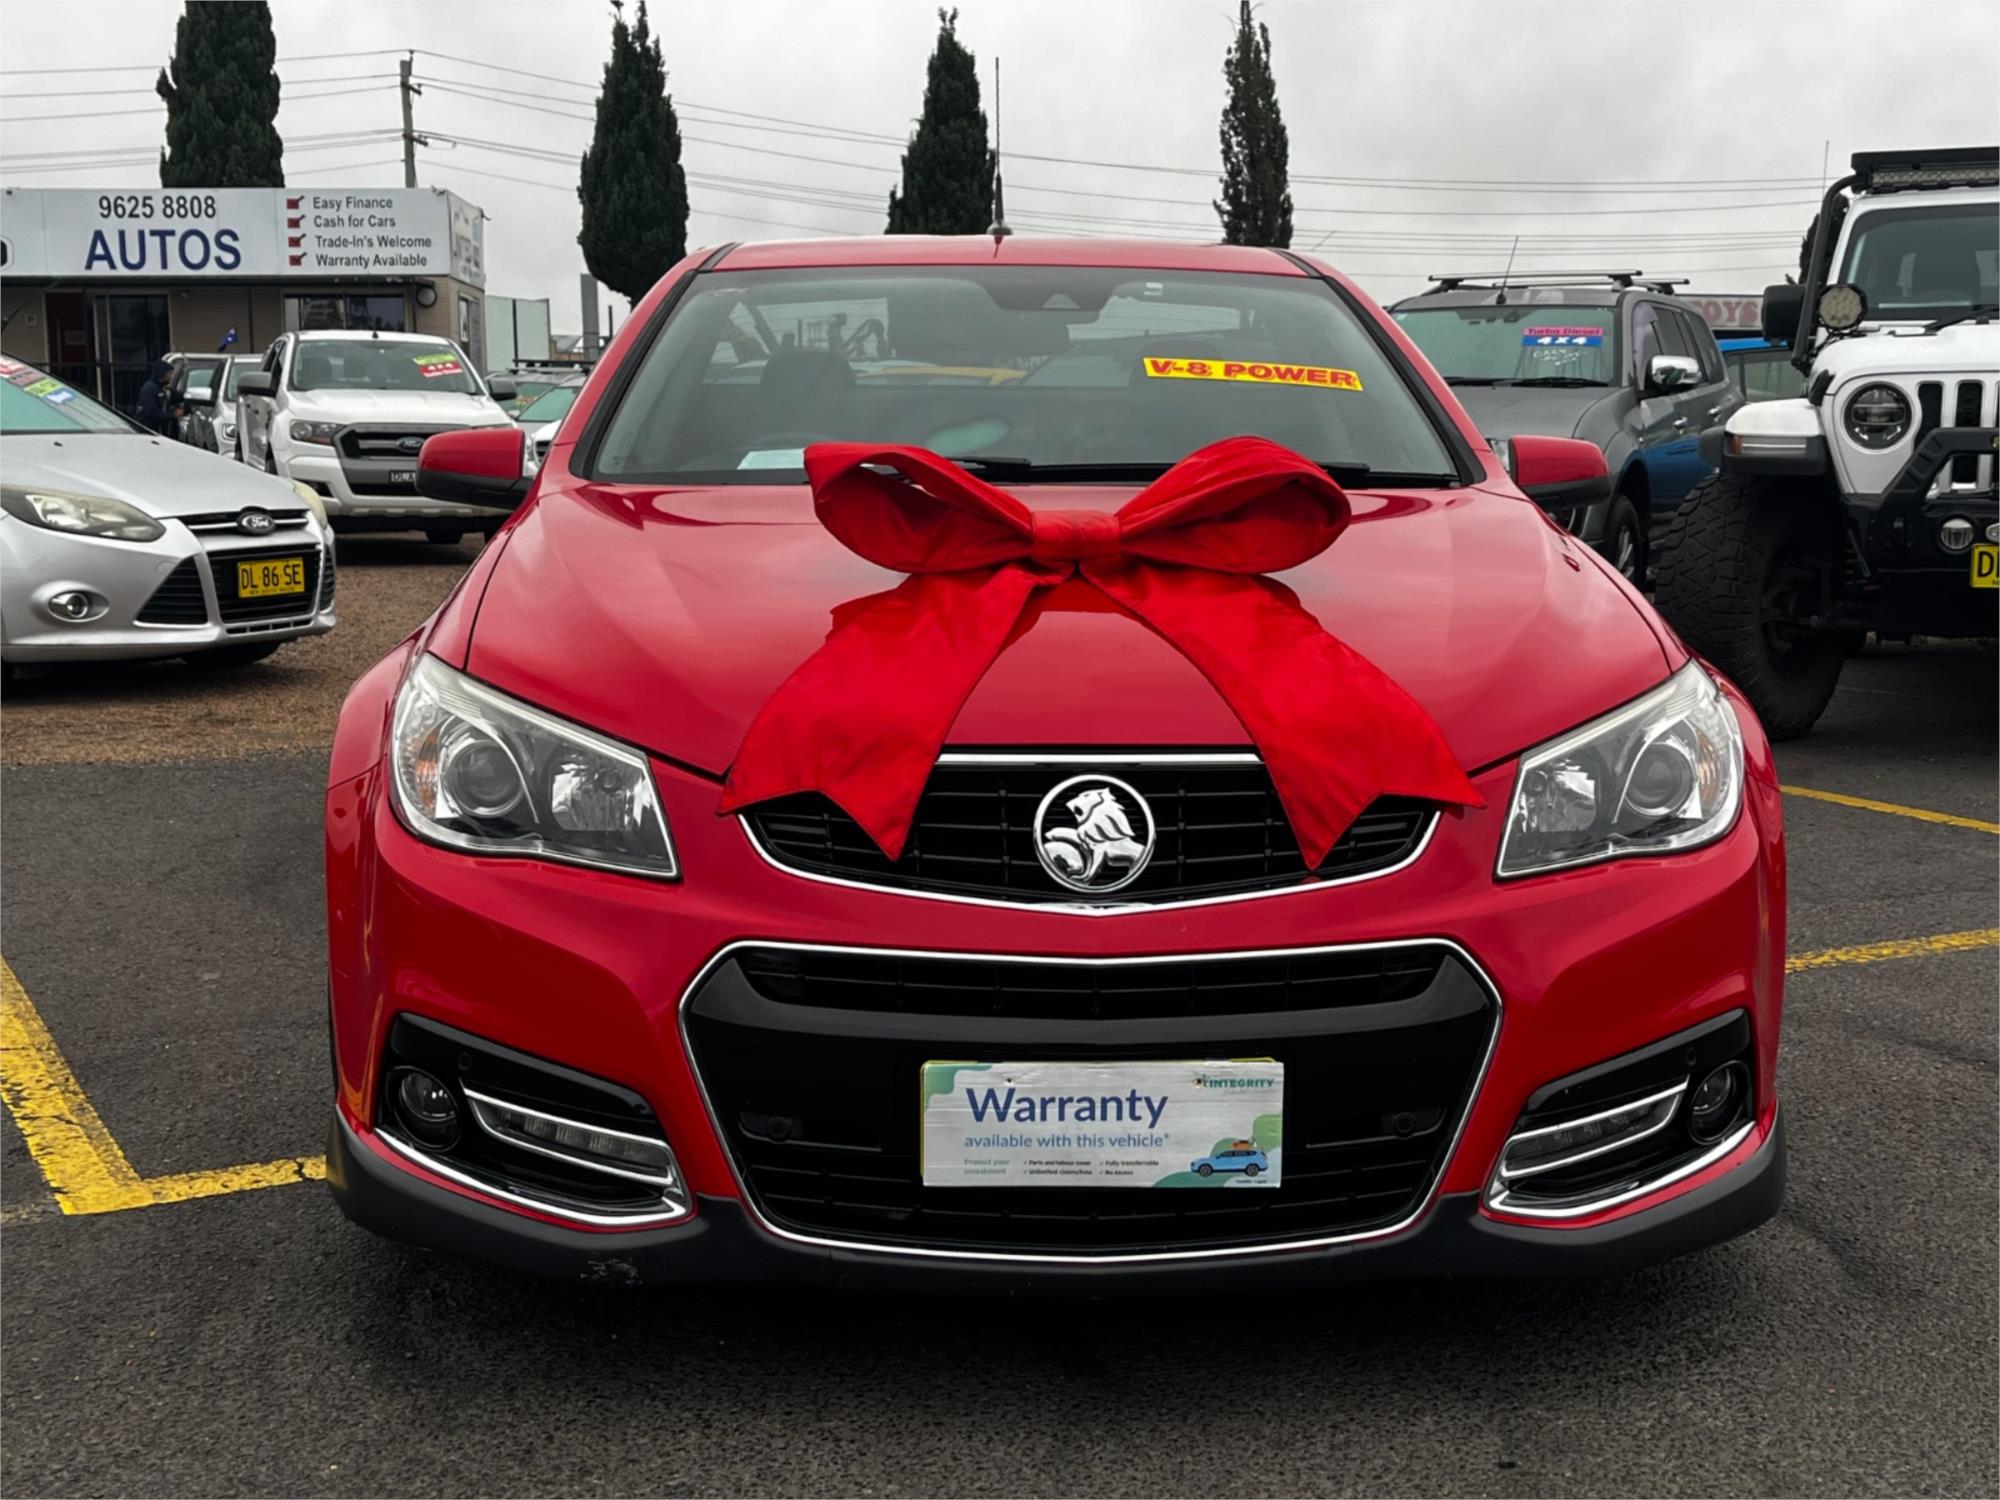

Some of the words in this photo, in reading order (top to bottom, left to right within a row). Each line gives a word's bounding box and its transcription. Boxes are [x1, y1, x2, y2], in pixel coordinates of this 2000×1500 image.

[98, 195, 154, 219] 9625
[162, 195, 217, 219] 8808
[313, 197, 342, 211] Easy
[346, 196, 393, 209] Finance
[313, 215, 345, 228] Cash
[348, 215, 364, 228] for
[367, 215, 396, 228] Cars
[84, 228, 241, 271] AUTOS
[315, 235, 373, 248] Trade-In's
[377, 235, 432, 248] Welcome
[315, 254, 369, 268] Warranty
[373, 253, 428, 267] Available
[1691, 301, 1758, 323] OYS
[1150, 359, 1213, 376] V-8
[1223, 362, 1357, 387] POWER
[1977, 550, 2000, 578] D
[241, 567, 258, 590] DL
[262, 566, 280, 587] 86
[283, 564, 302, 586] SE
[1209, 1078, 1275, 1088] INTEGRITY
[965, 1087, 1169, 1129] Warranty
[964, 1133, 1033, 1148] available
[1036, 1133, 1072, 1148] with
[1076, 1133, 1105, 1148] this
